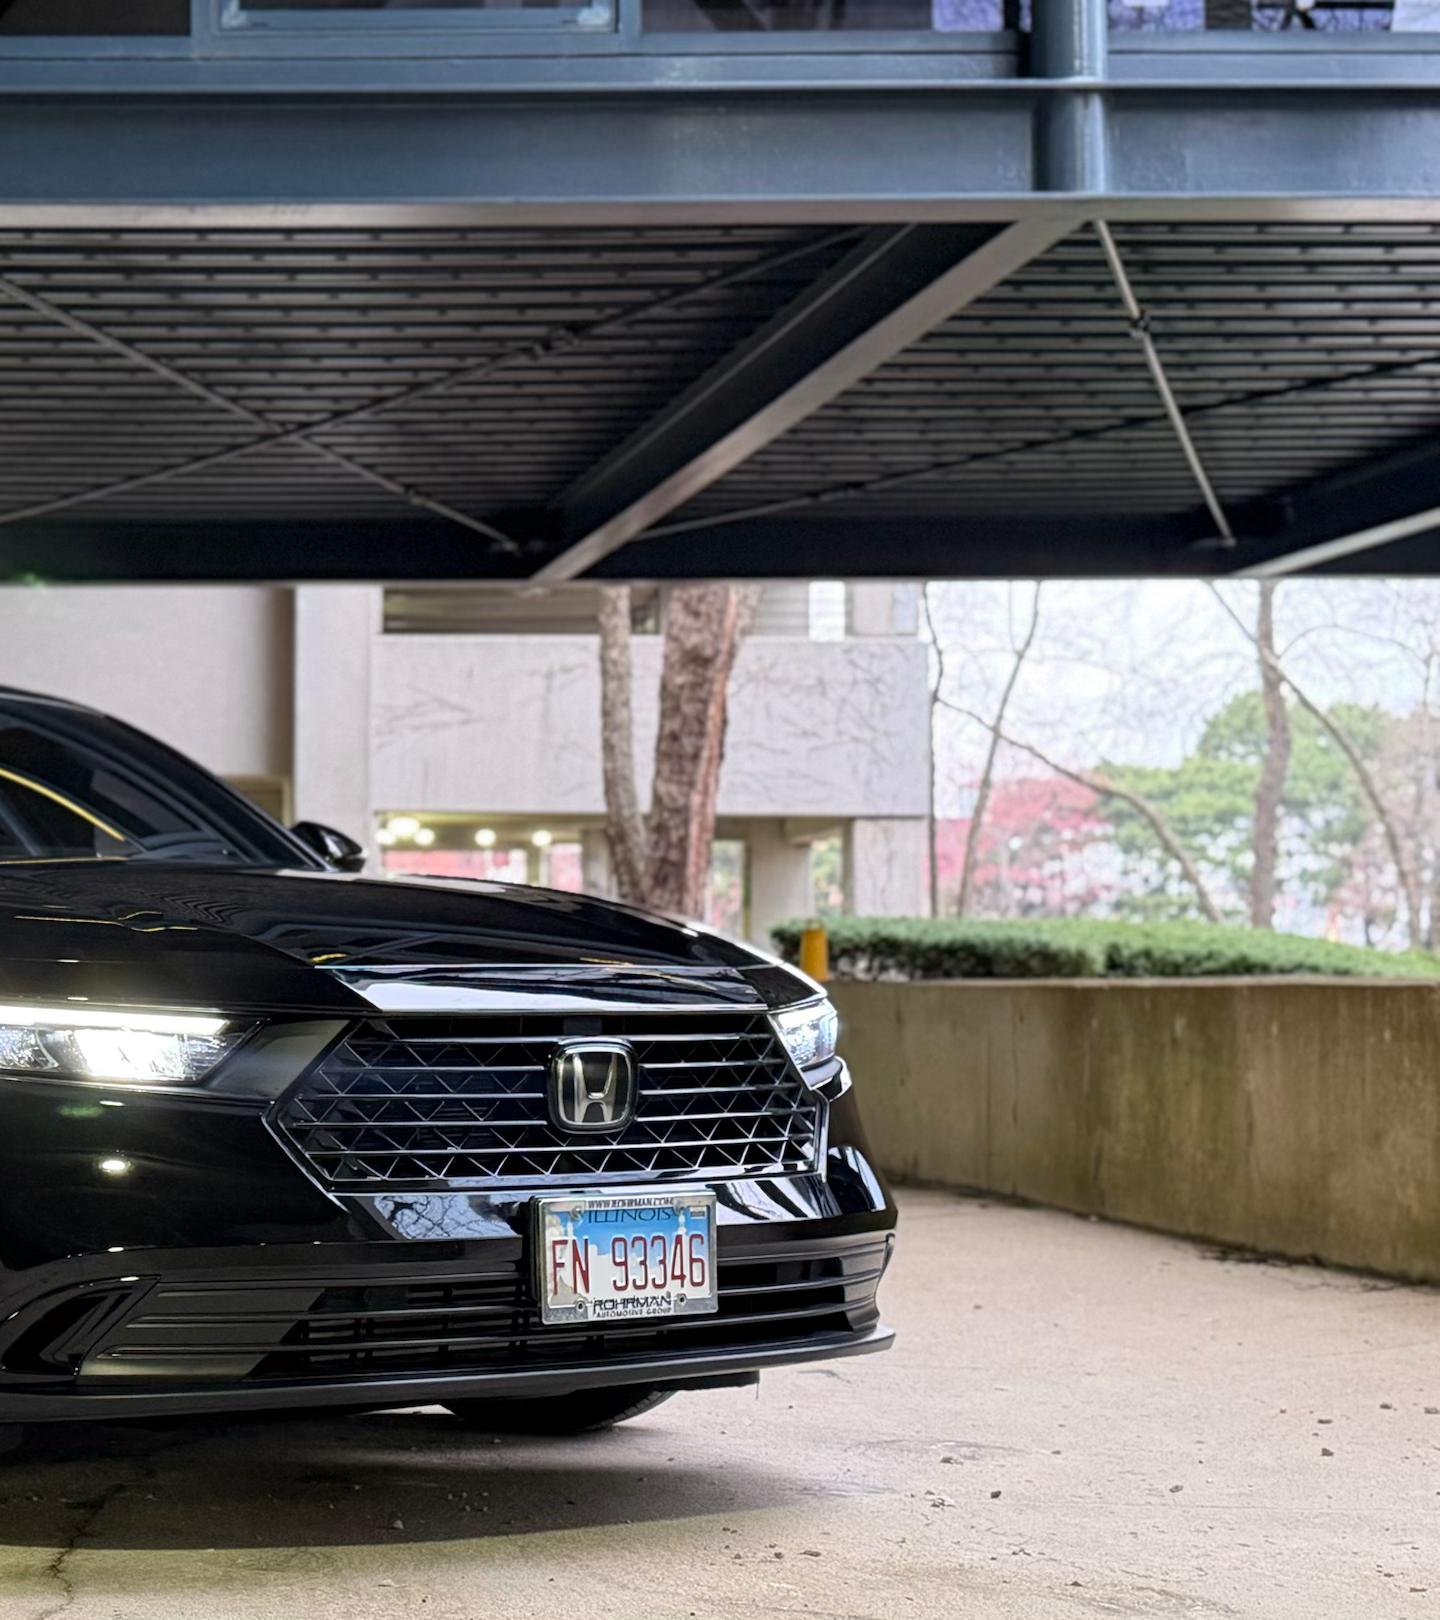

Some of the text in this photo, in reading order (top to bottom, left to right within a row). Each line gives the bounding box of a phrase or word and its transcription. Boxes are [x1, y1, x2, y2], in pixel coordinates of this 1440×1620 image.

[588, 1207, 671, 1223] ILLINOIS
[552, 1233, 705, 1296] FN 93346
[593, 1295, 671, 1313] ROHRMAN
[596, 1307, 672, 1318] AUTOMOTIVE GROUP
